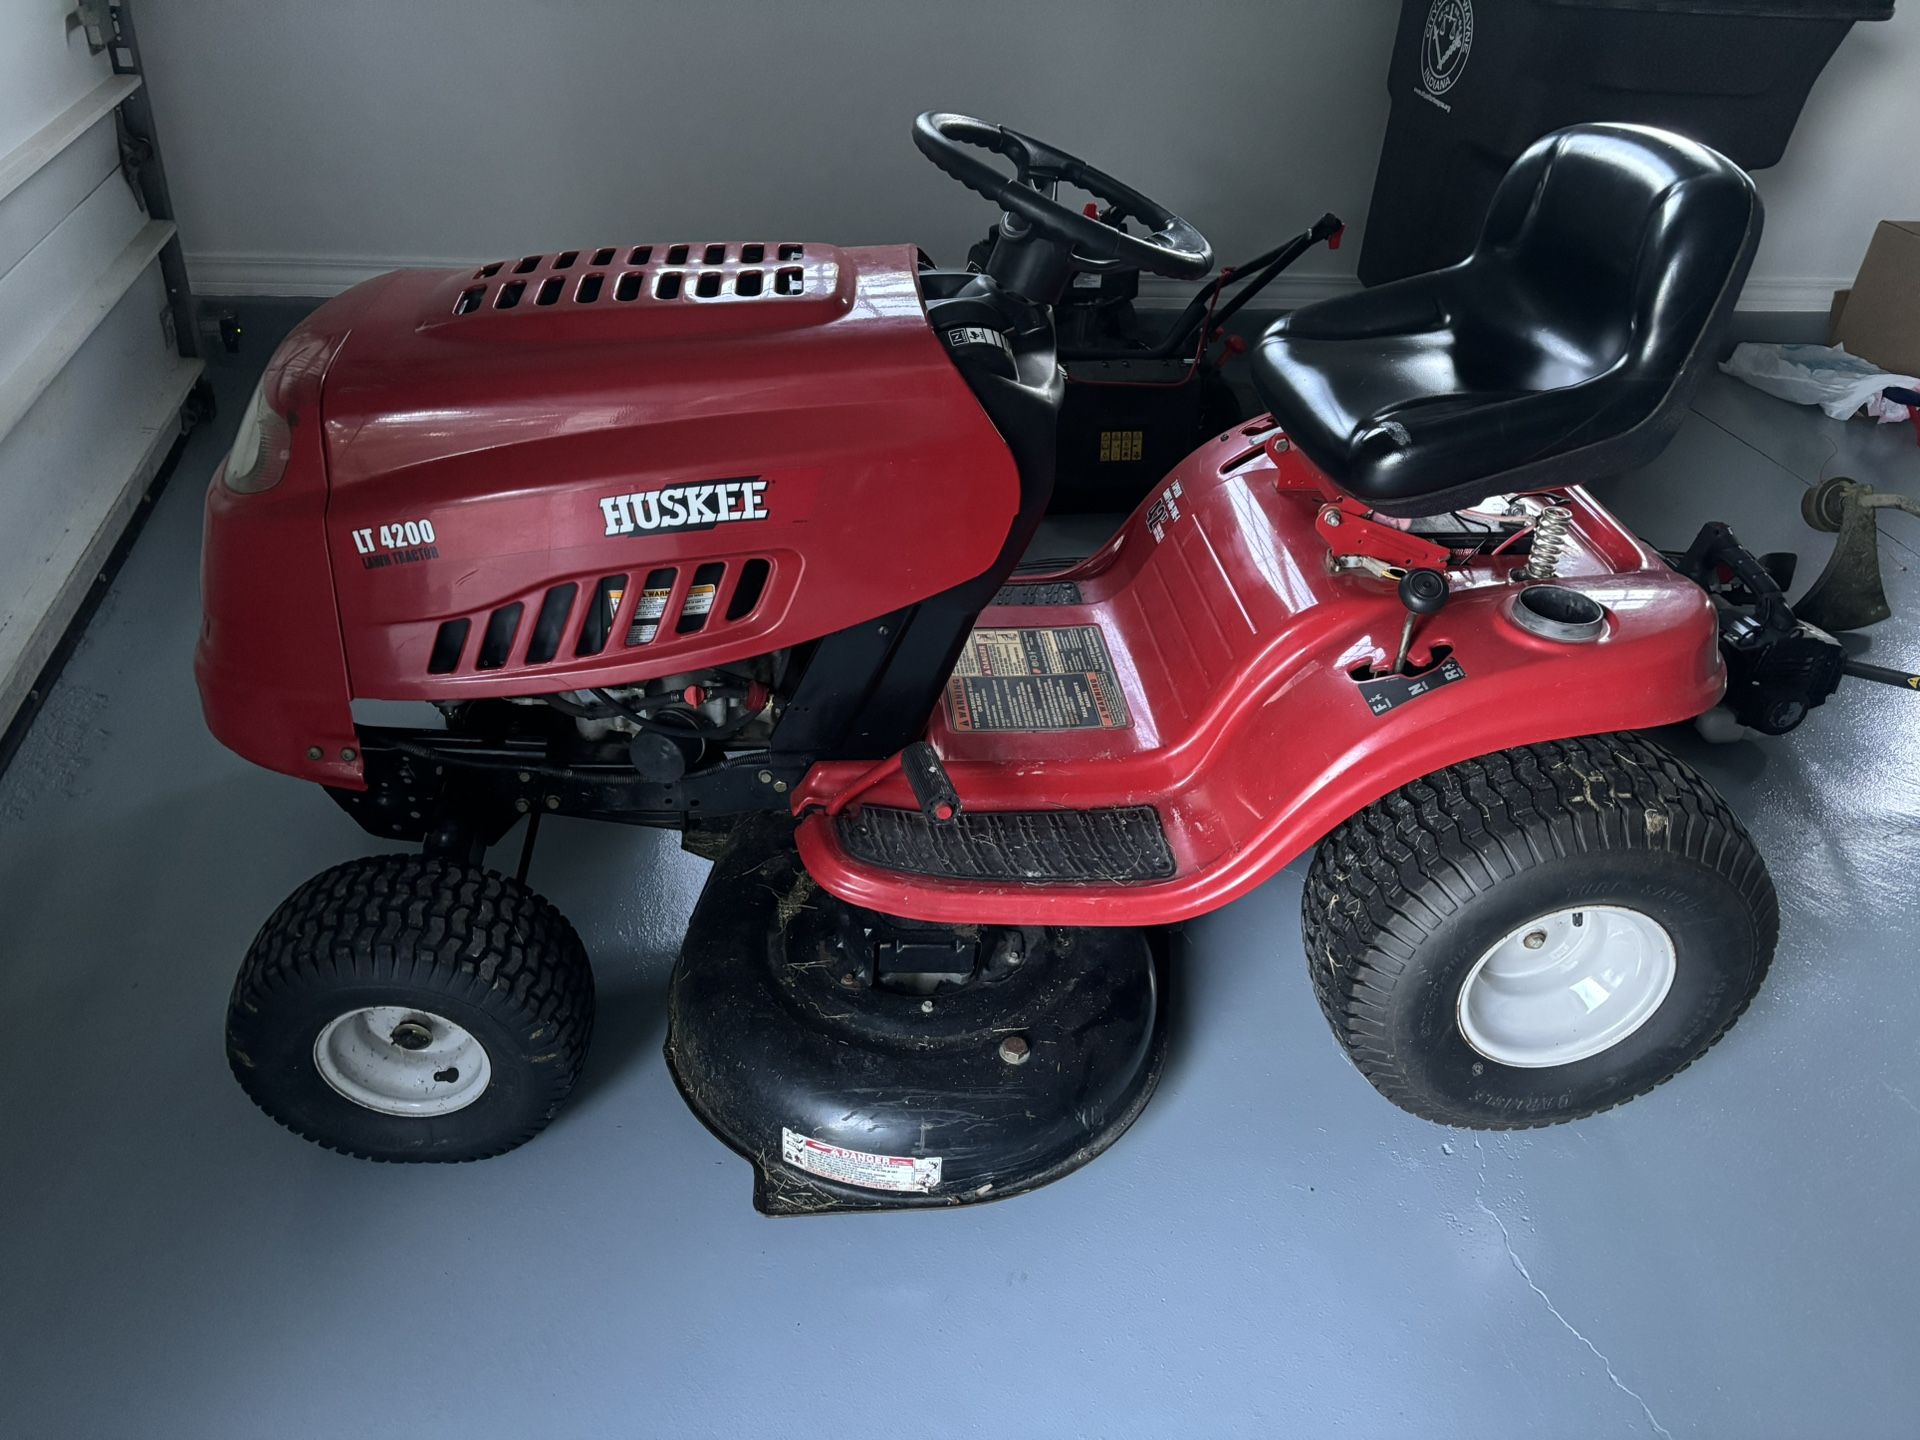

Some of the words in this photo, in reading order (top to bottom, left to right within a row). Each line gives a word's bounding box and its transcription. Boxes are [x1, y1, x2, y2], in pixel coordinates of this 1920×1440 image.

[1423, 67, 1451, 91] INDIANA
[600, 481, 768, 536] HUSKEE
[352, 528, 376, 554] LT
[380, 519, 435, 549] 4200
[392, 546, 439, 565] TRACTOR
[978, 645, 991, 670] DANGER
[1444, 669, 1459, 680] R
[952, 678, 967, 719] WARNING
[1089, 678, 1107, 711] WARNING
[1408, 683, 1424, 695] N
[1373, 703, 1387, 713] F
[842, 1150, 890, 1165] DANGER
